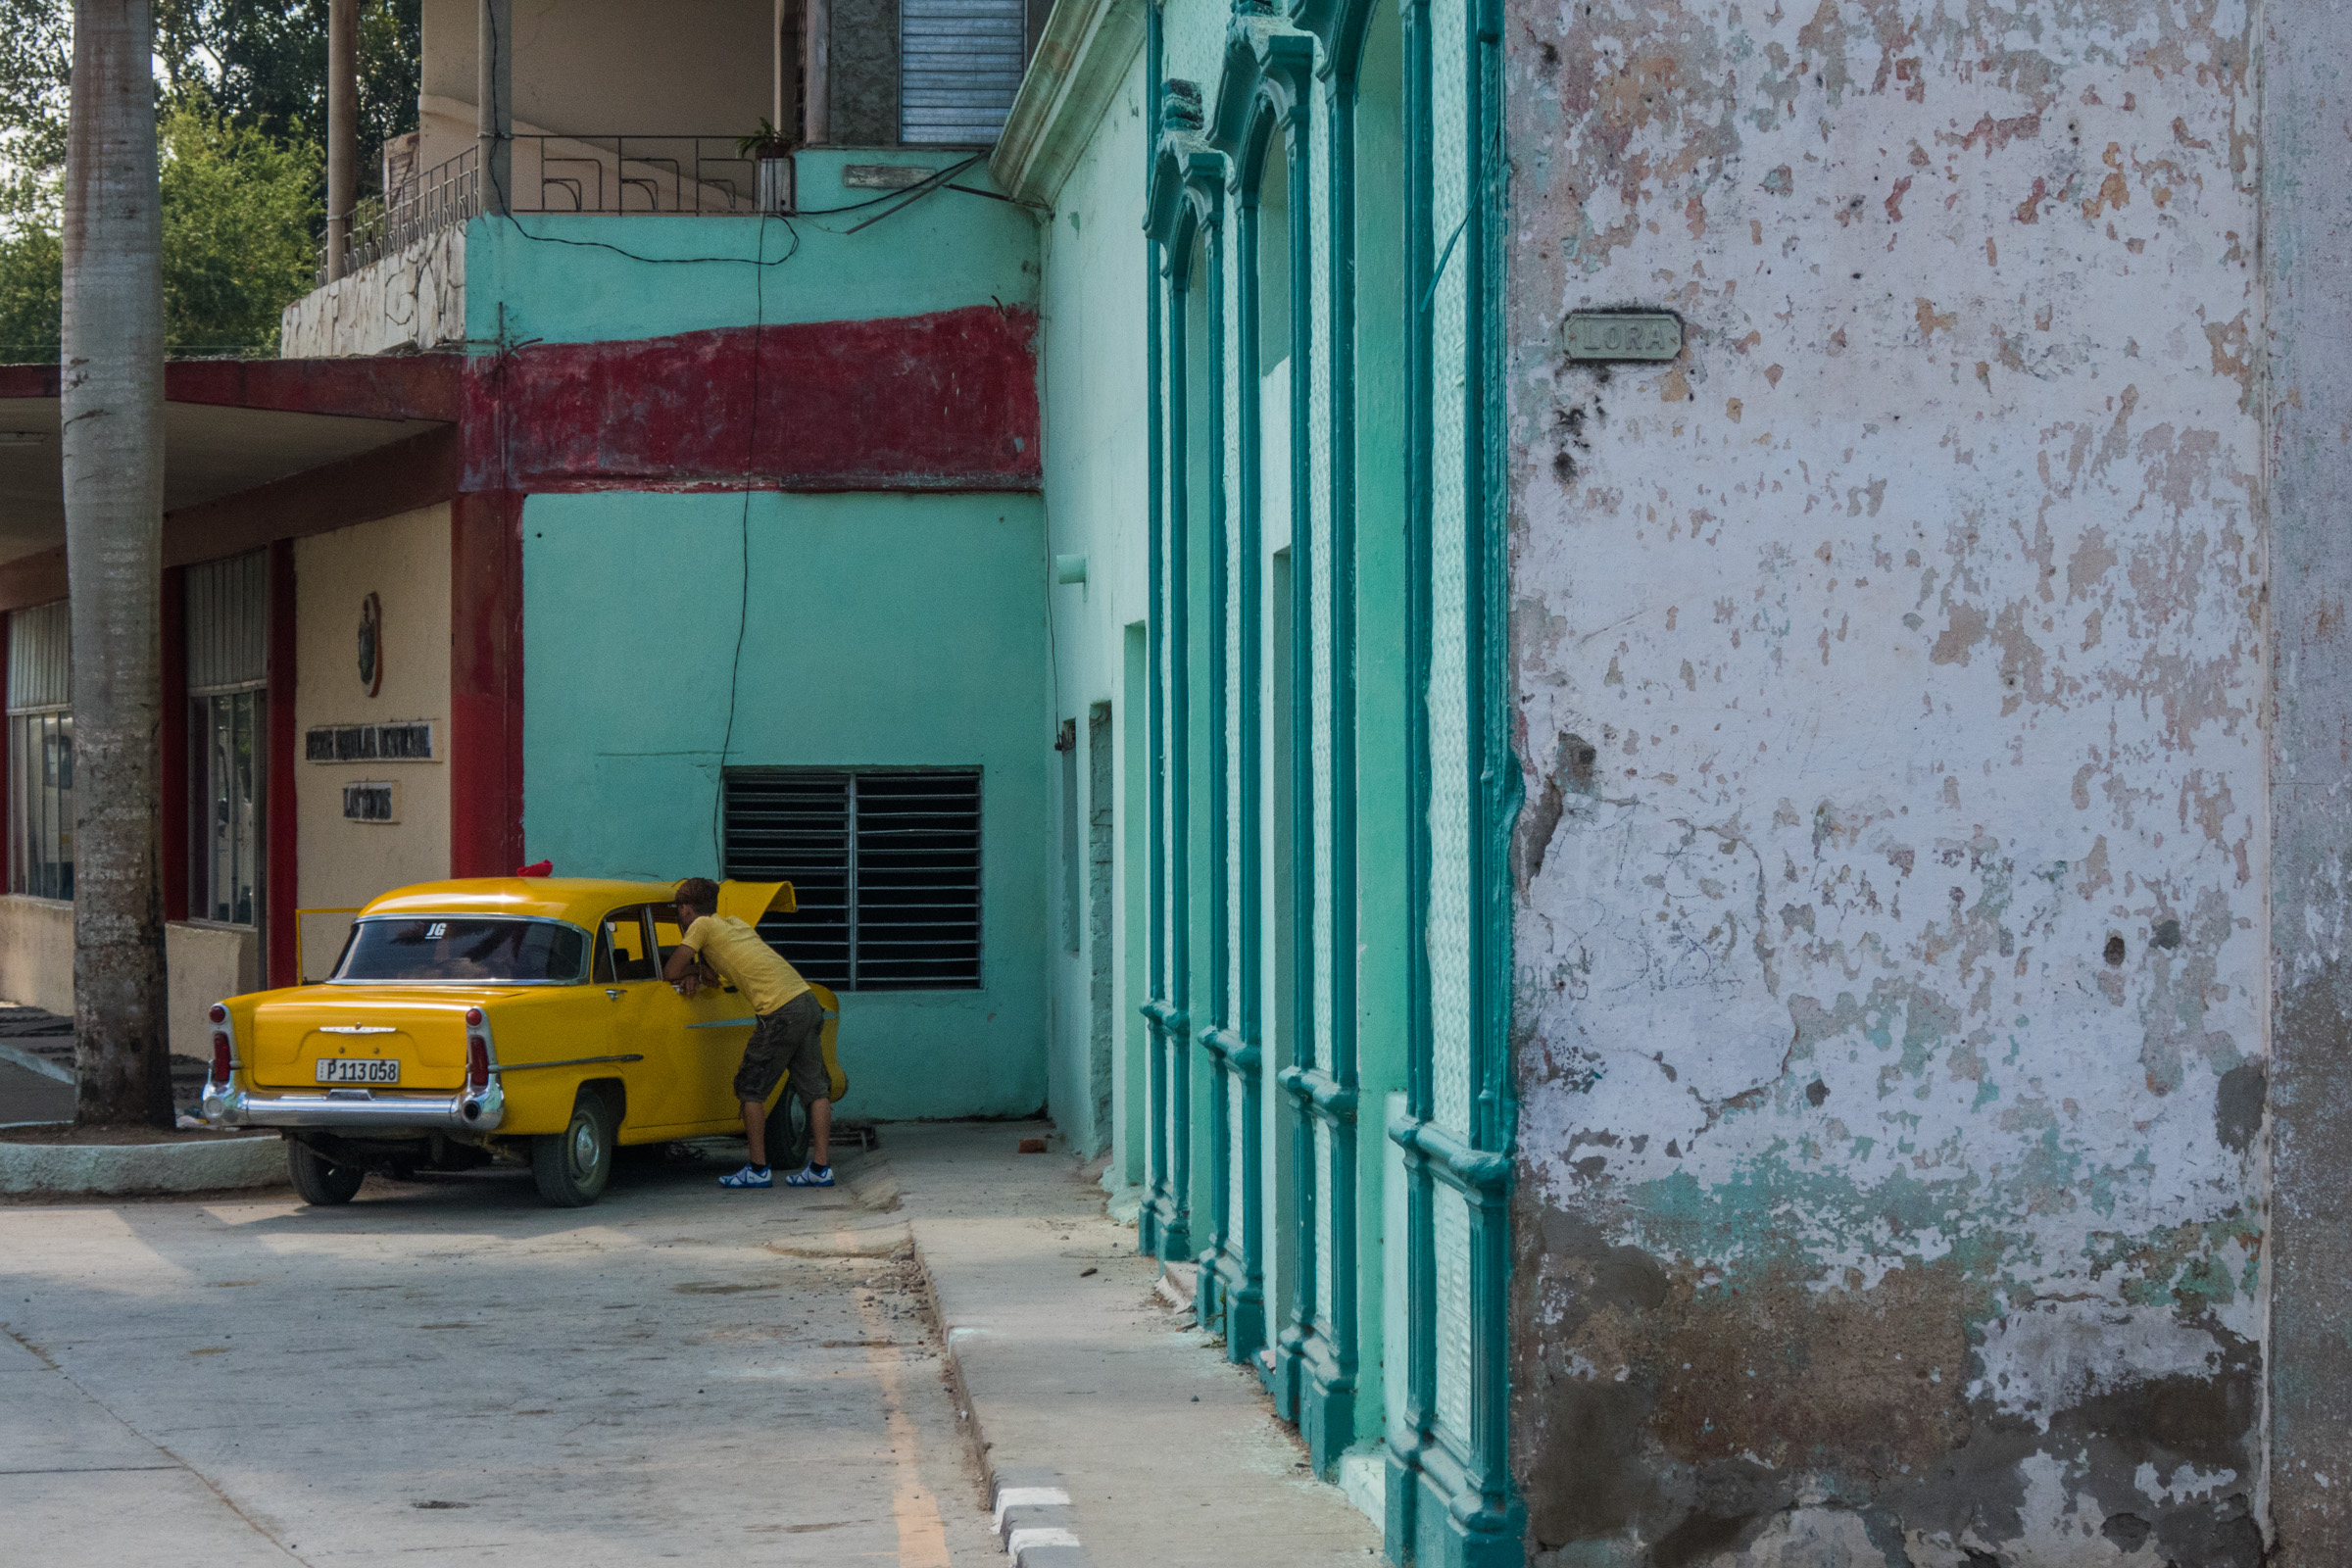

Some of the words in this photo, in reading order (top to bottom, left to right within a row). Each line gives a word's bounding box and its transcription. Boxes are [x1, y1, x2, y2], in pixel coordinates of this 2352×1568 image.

[1583, 321, 1666, 350] LORA
[425, 922, 447, 936] JG
[368, 1062, 397, 1081] 058
